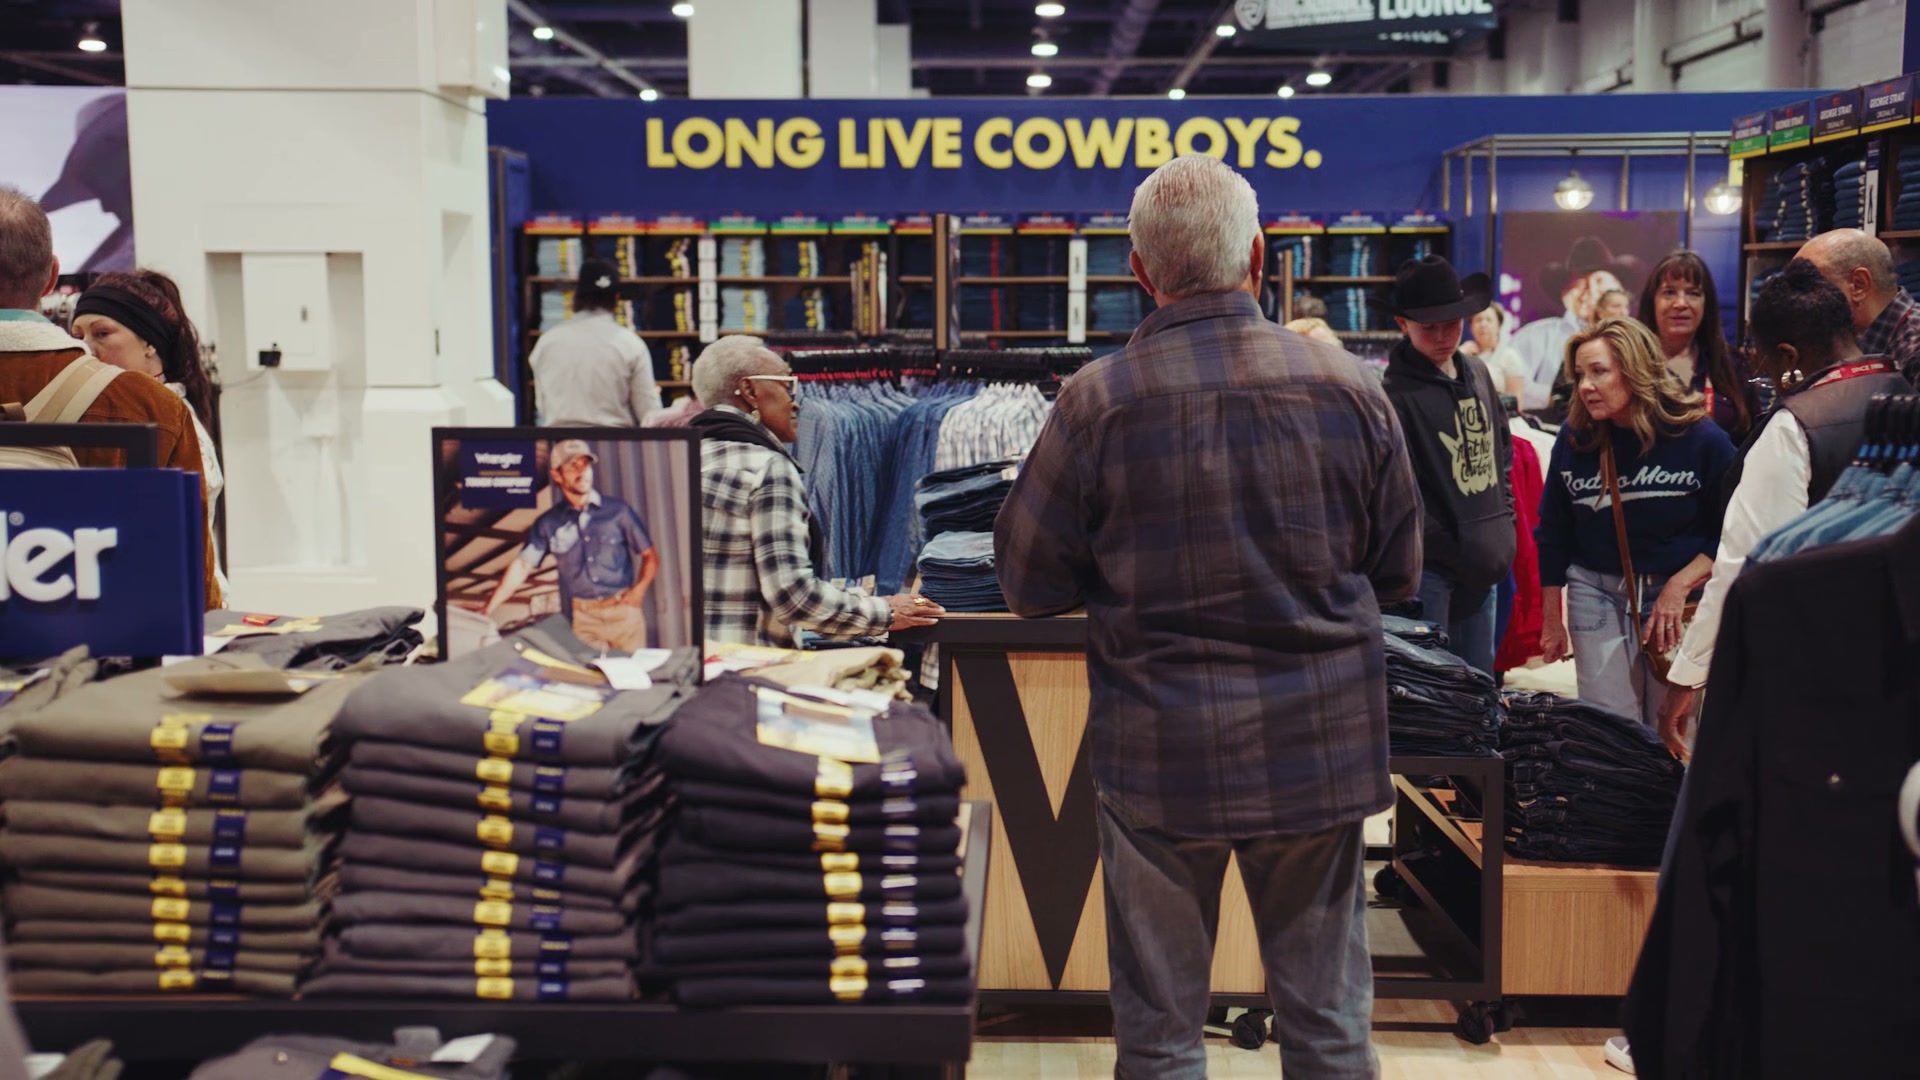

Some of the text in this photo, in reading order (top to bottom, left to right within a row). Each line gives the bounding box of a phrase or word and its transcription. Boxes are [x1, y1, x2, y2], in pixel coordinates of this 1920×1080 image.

[647, 117, 1321, 168] LONG LIVE COWBOYS.
[1560, 465, 1701, 496] Rodo Mom
